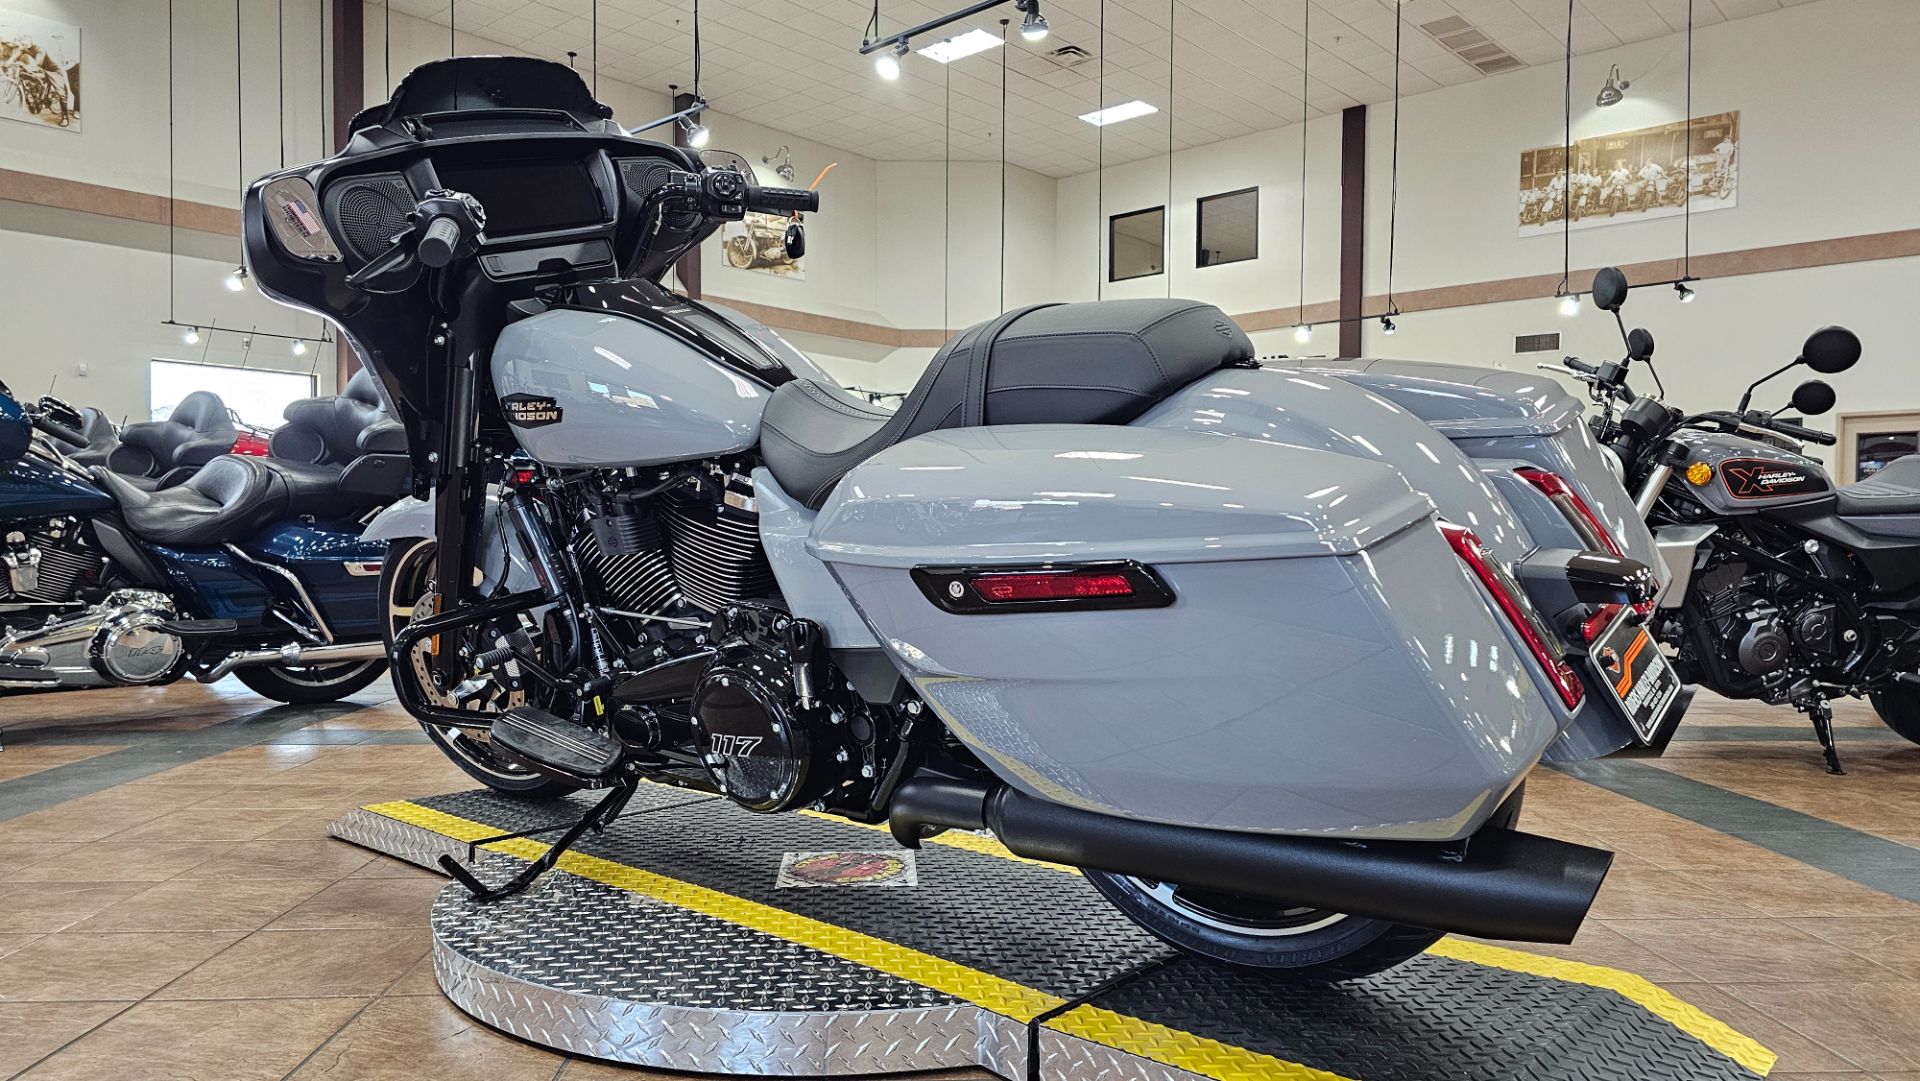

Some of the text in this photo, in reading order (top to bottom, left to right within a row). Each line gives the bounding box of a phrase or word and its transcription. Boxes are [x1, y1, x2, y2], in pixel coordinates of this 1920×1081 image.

[507, 401, 552, 411] RLEY-
[1758, 472, 1797, 480] HARLEY-
[1760, 476, 1805, 485] DAVIDSON
[711, 733, 763, 757] 117
